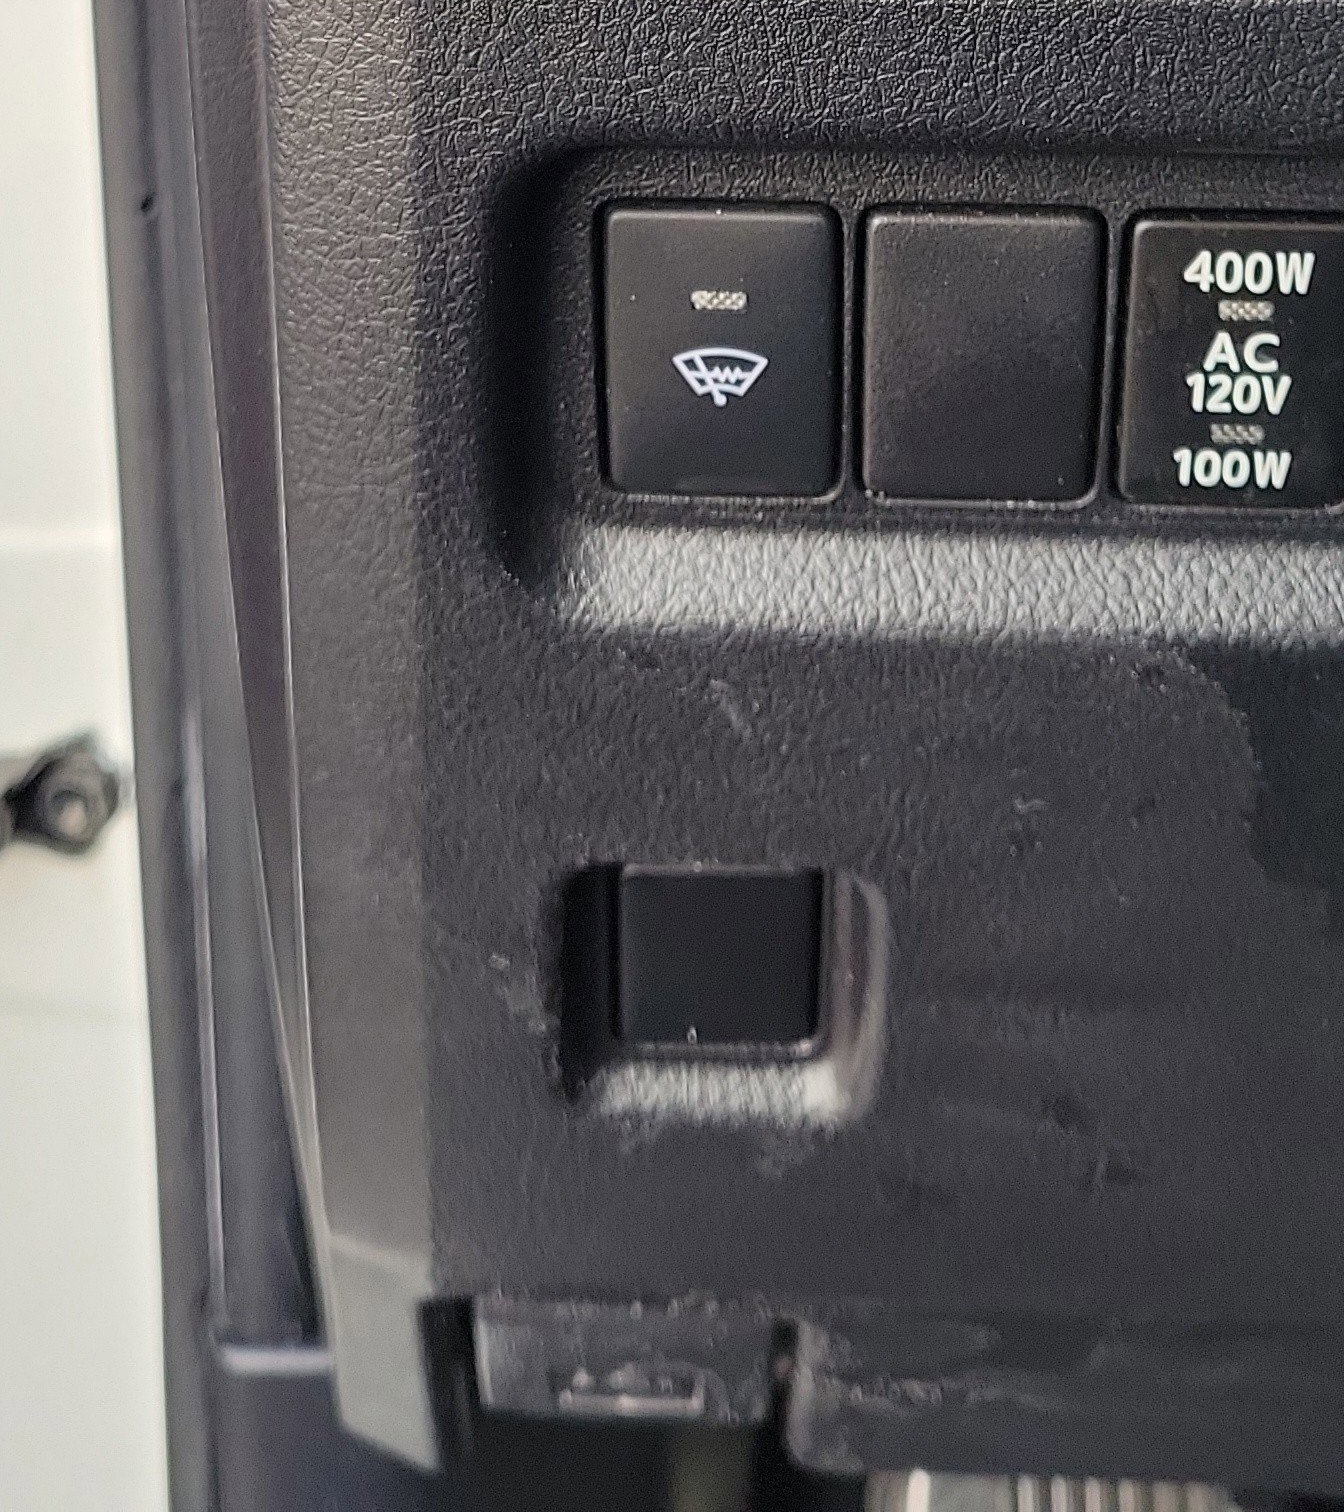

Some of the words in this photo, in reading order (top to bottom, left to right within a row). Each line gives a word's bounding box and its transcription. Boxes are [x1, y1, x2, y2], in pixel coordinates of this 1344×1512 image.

[1182, 249, 1316, 295] 400W
[1202, 329, 1281, 373] AC
[1185, 371, 1293, 416] 120V
[1172, 446, 1293, 491] 100W
